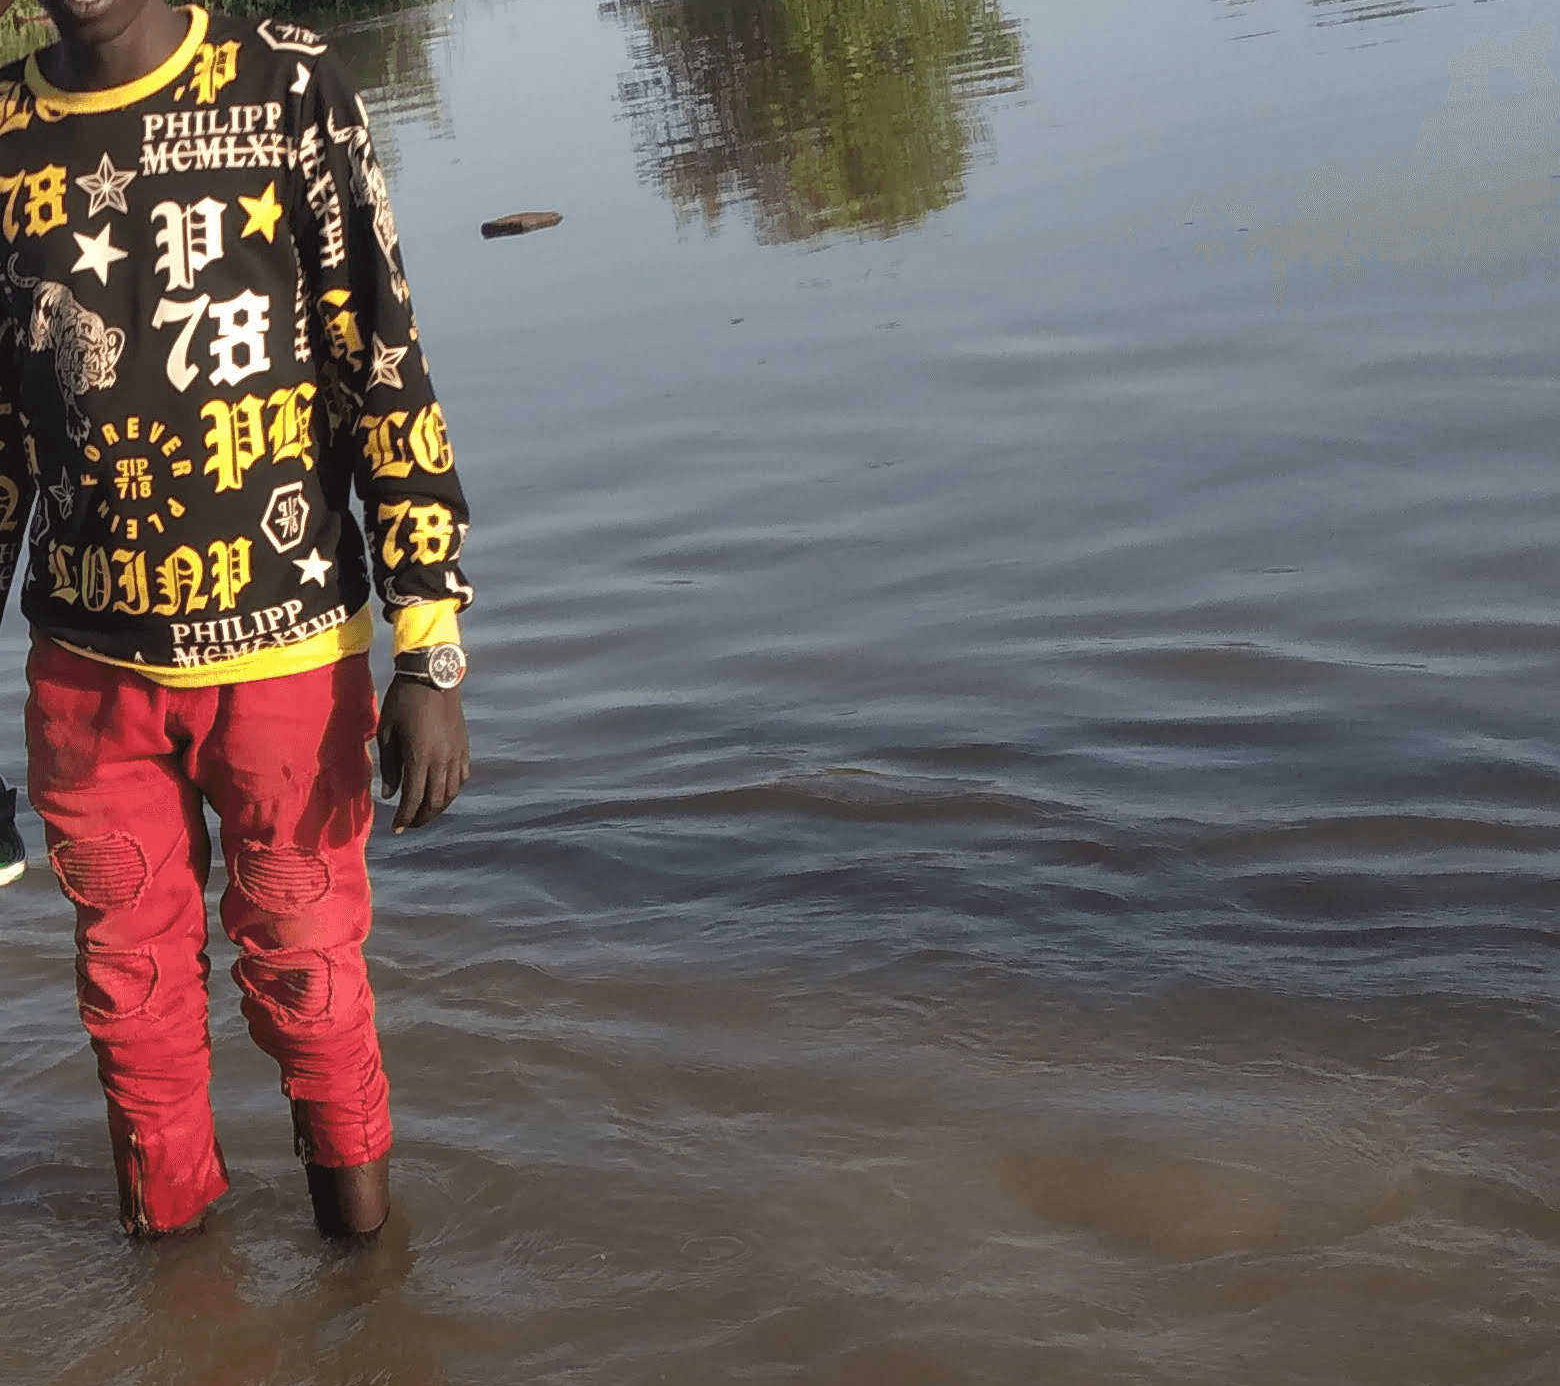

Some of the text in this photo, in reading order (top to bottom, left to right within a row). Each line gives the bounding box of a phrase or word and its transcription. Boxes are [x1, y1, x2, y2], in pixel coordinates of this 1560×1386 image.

[142, 102, 282, 142] PHILIPP
[151, 288, 272, 393] 78
[80, 416, 193, 486] FOREVER
[97, 497, 186, 540] PLEIN
[377, 499, 453, 571] 78
[170, 598, 303, 645] PHILIPP
